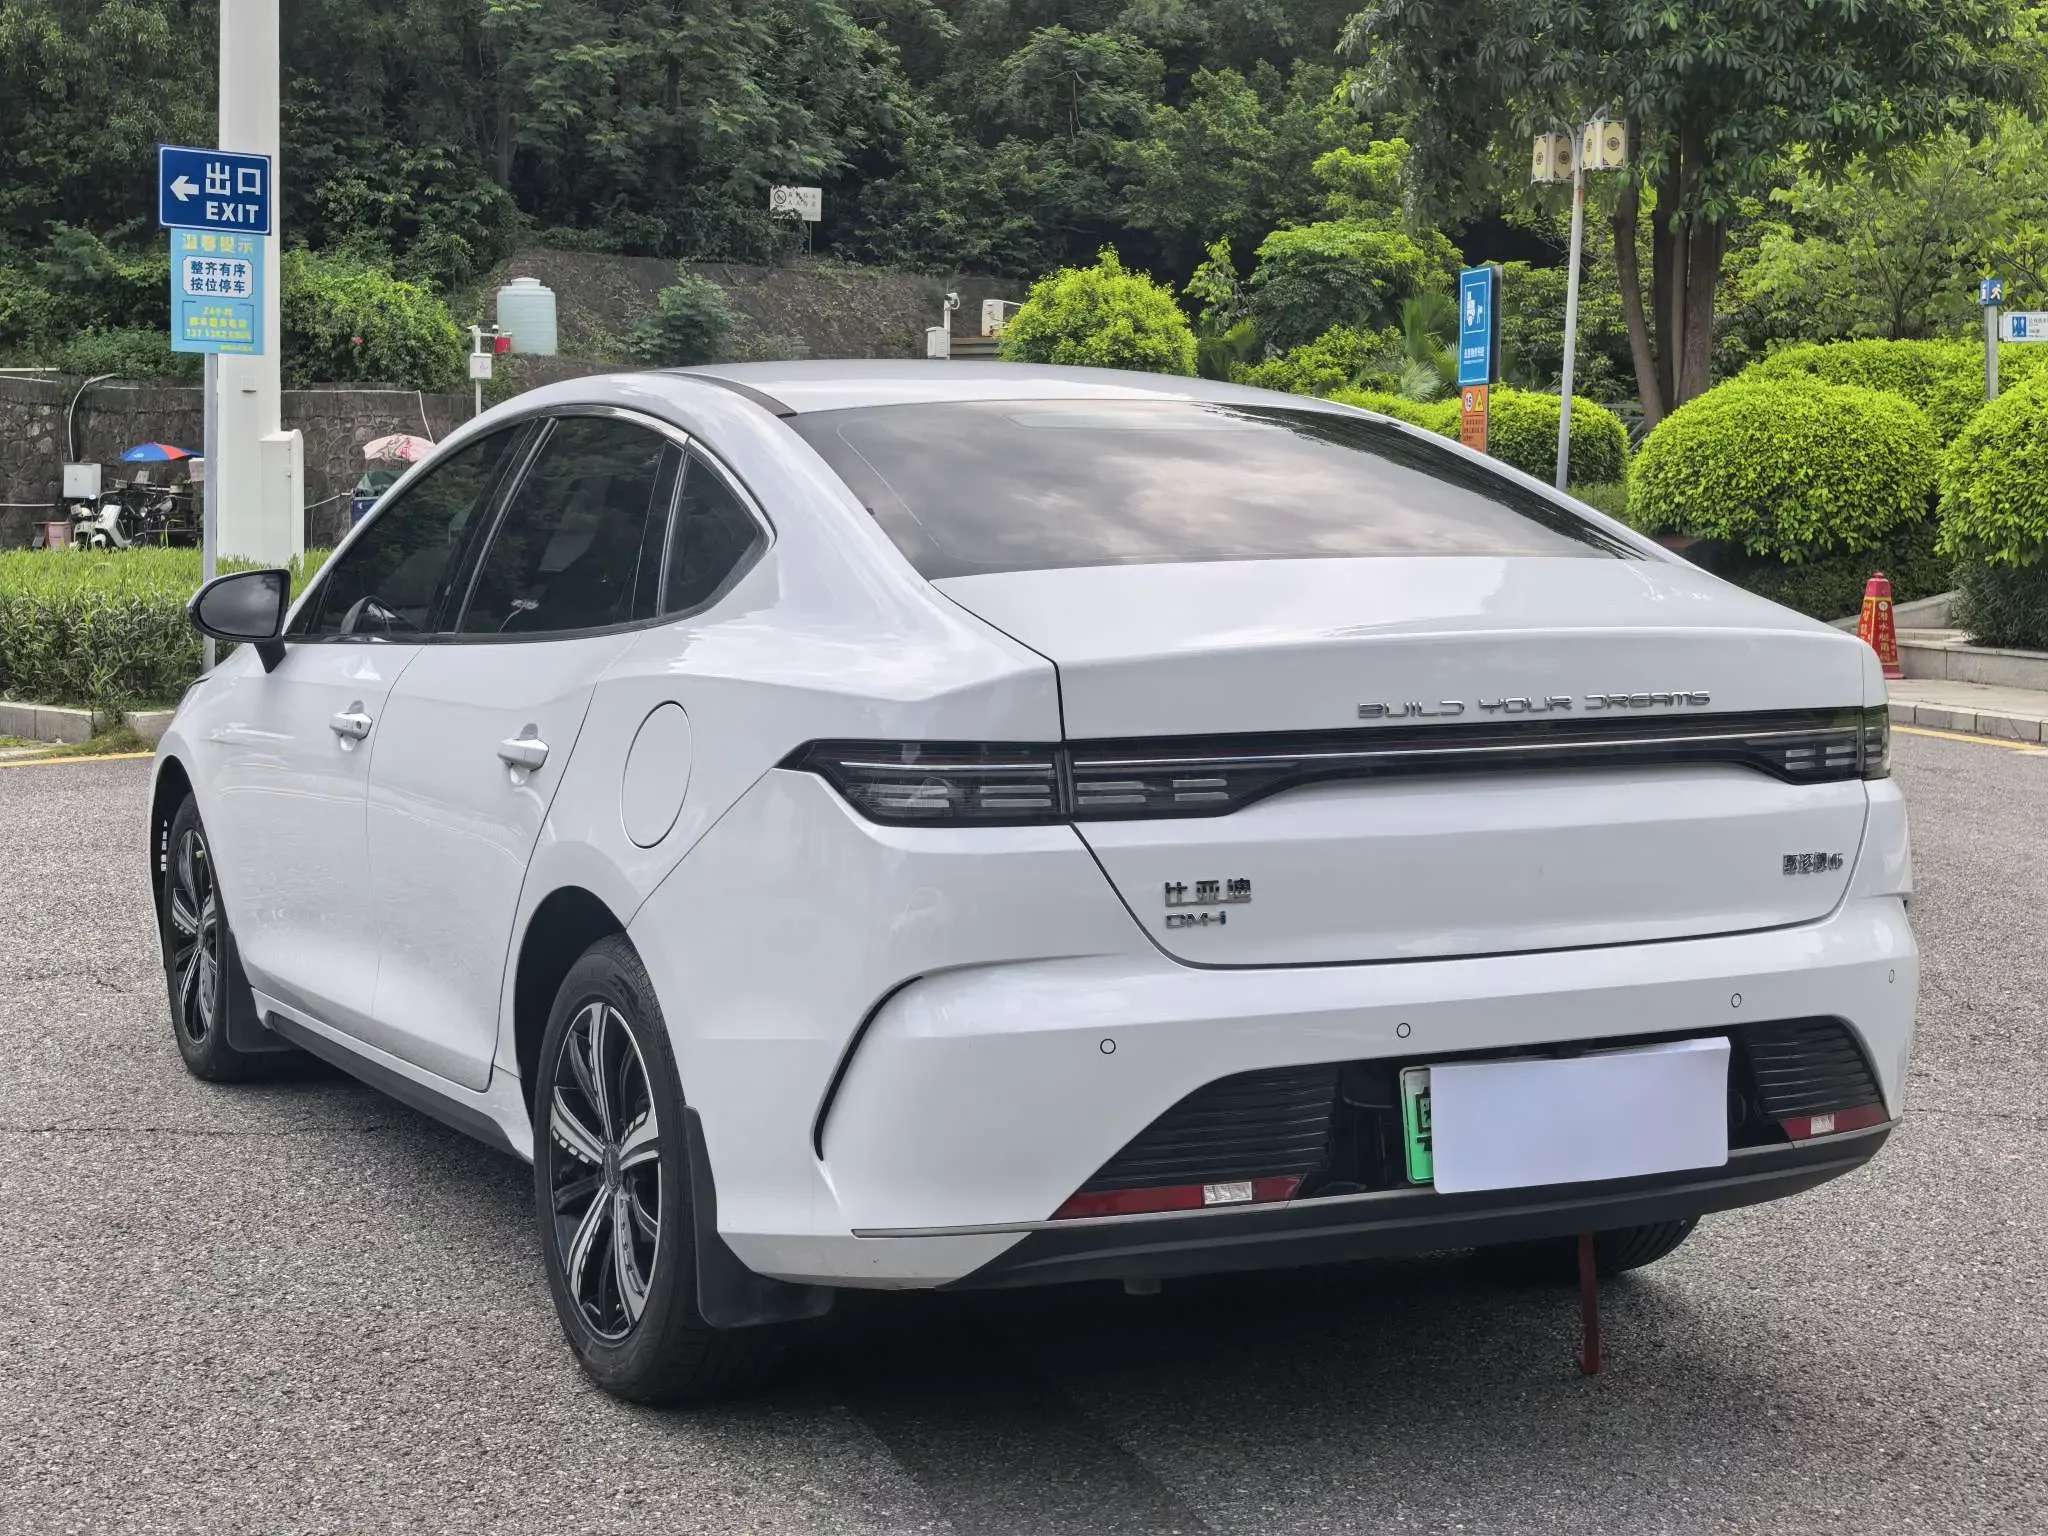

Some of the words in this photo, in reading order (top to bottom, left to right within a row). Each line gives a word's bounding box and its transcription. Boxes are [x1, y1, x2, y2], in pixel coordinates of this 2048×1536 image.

[205, 162, 261, 196] 出口
[206, 201, 259, 224] EXIT
[190, 260, 246, 279] 整齐有序
[190, 276, 246, 294] 按位停车
[1358, 700, 1465, 719] BUILD
[1478, 695, 1574, 714] YOUR
[1584, 690, 1711, 710] DREAMS
[1164, 878, 1252, 907] 比亚迪
